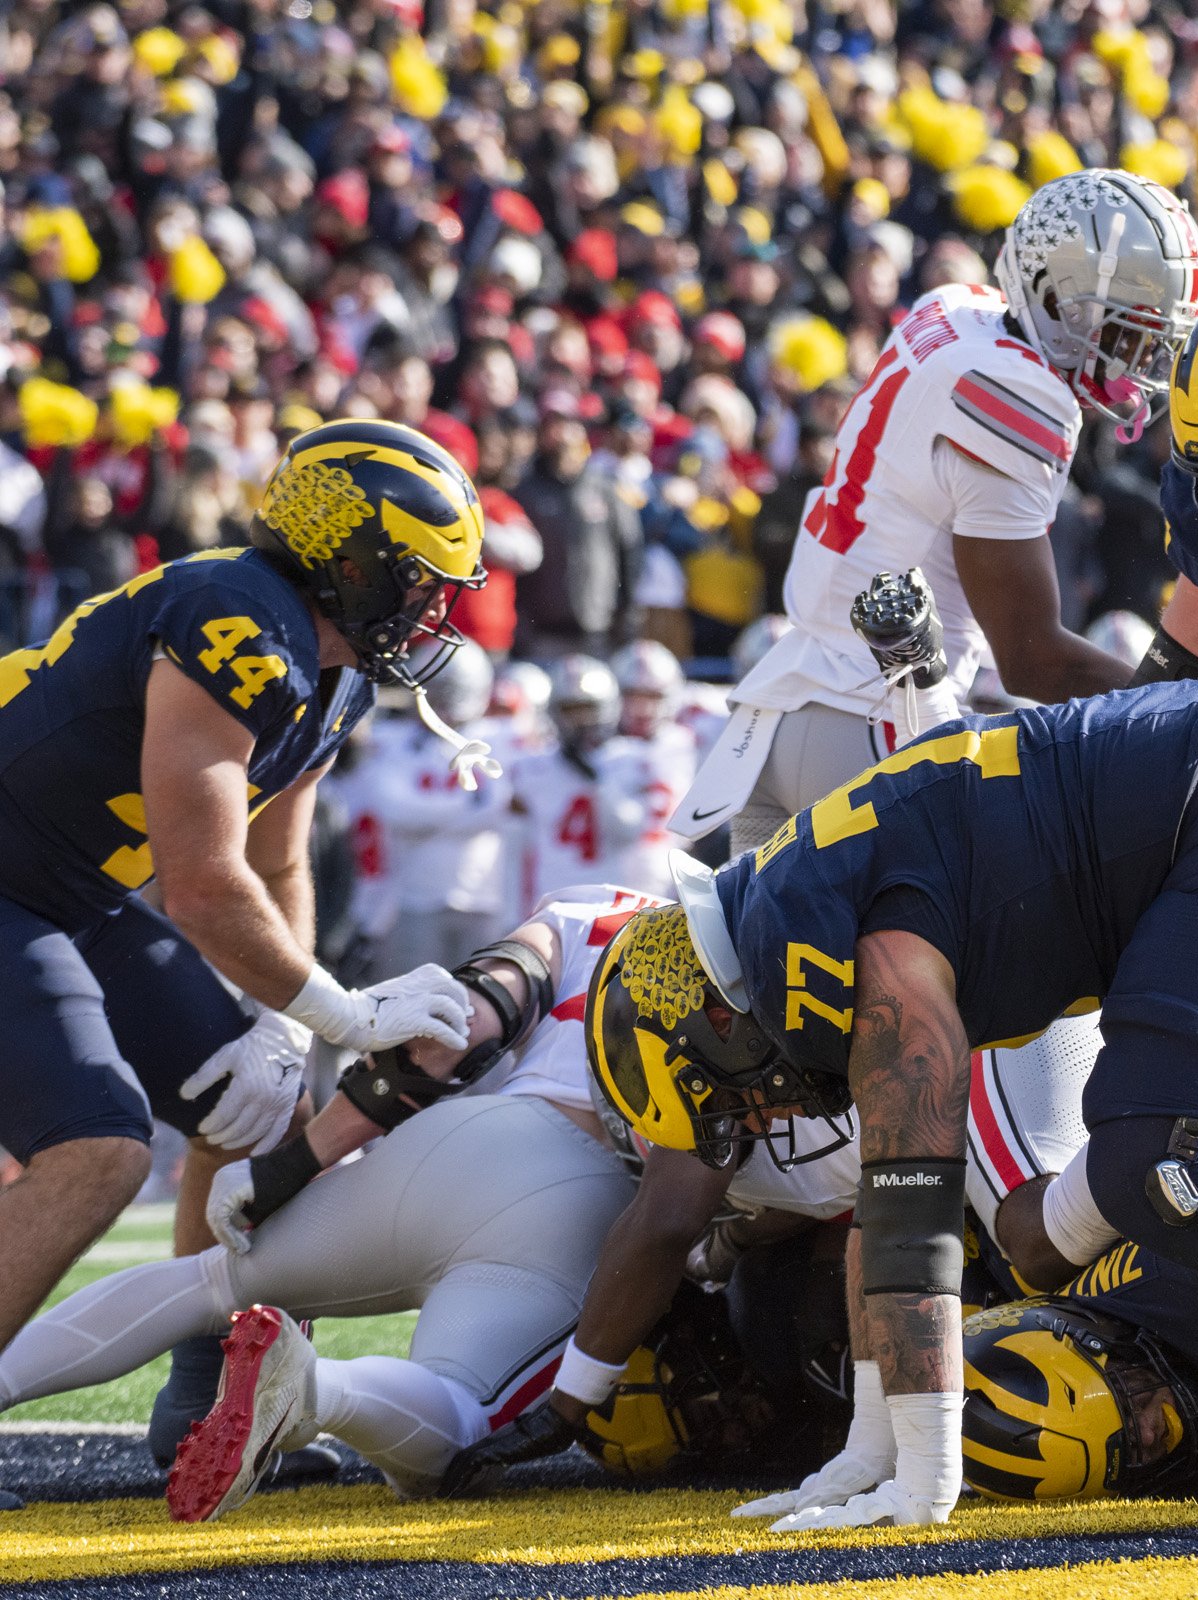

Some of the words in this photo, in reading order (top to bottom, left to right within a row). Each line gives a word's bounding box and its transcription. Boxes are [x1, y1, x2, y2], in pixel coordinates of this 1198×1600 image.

[900, 301, 960, 364] PROCTOR
[197, 616, 288, 710] 44
[785, 942, 855, 1035] 77
